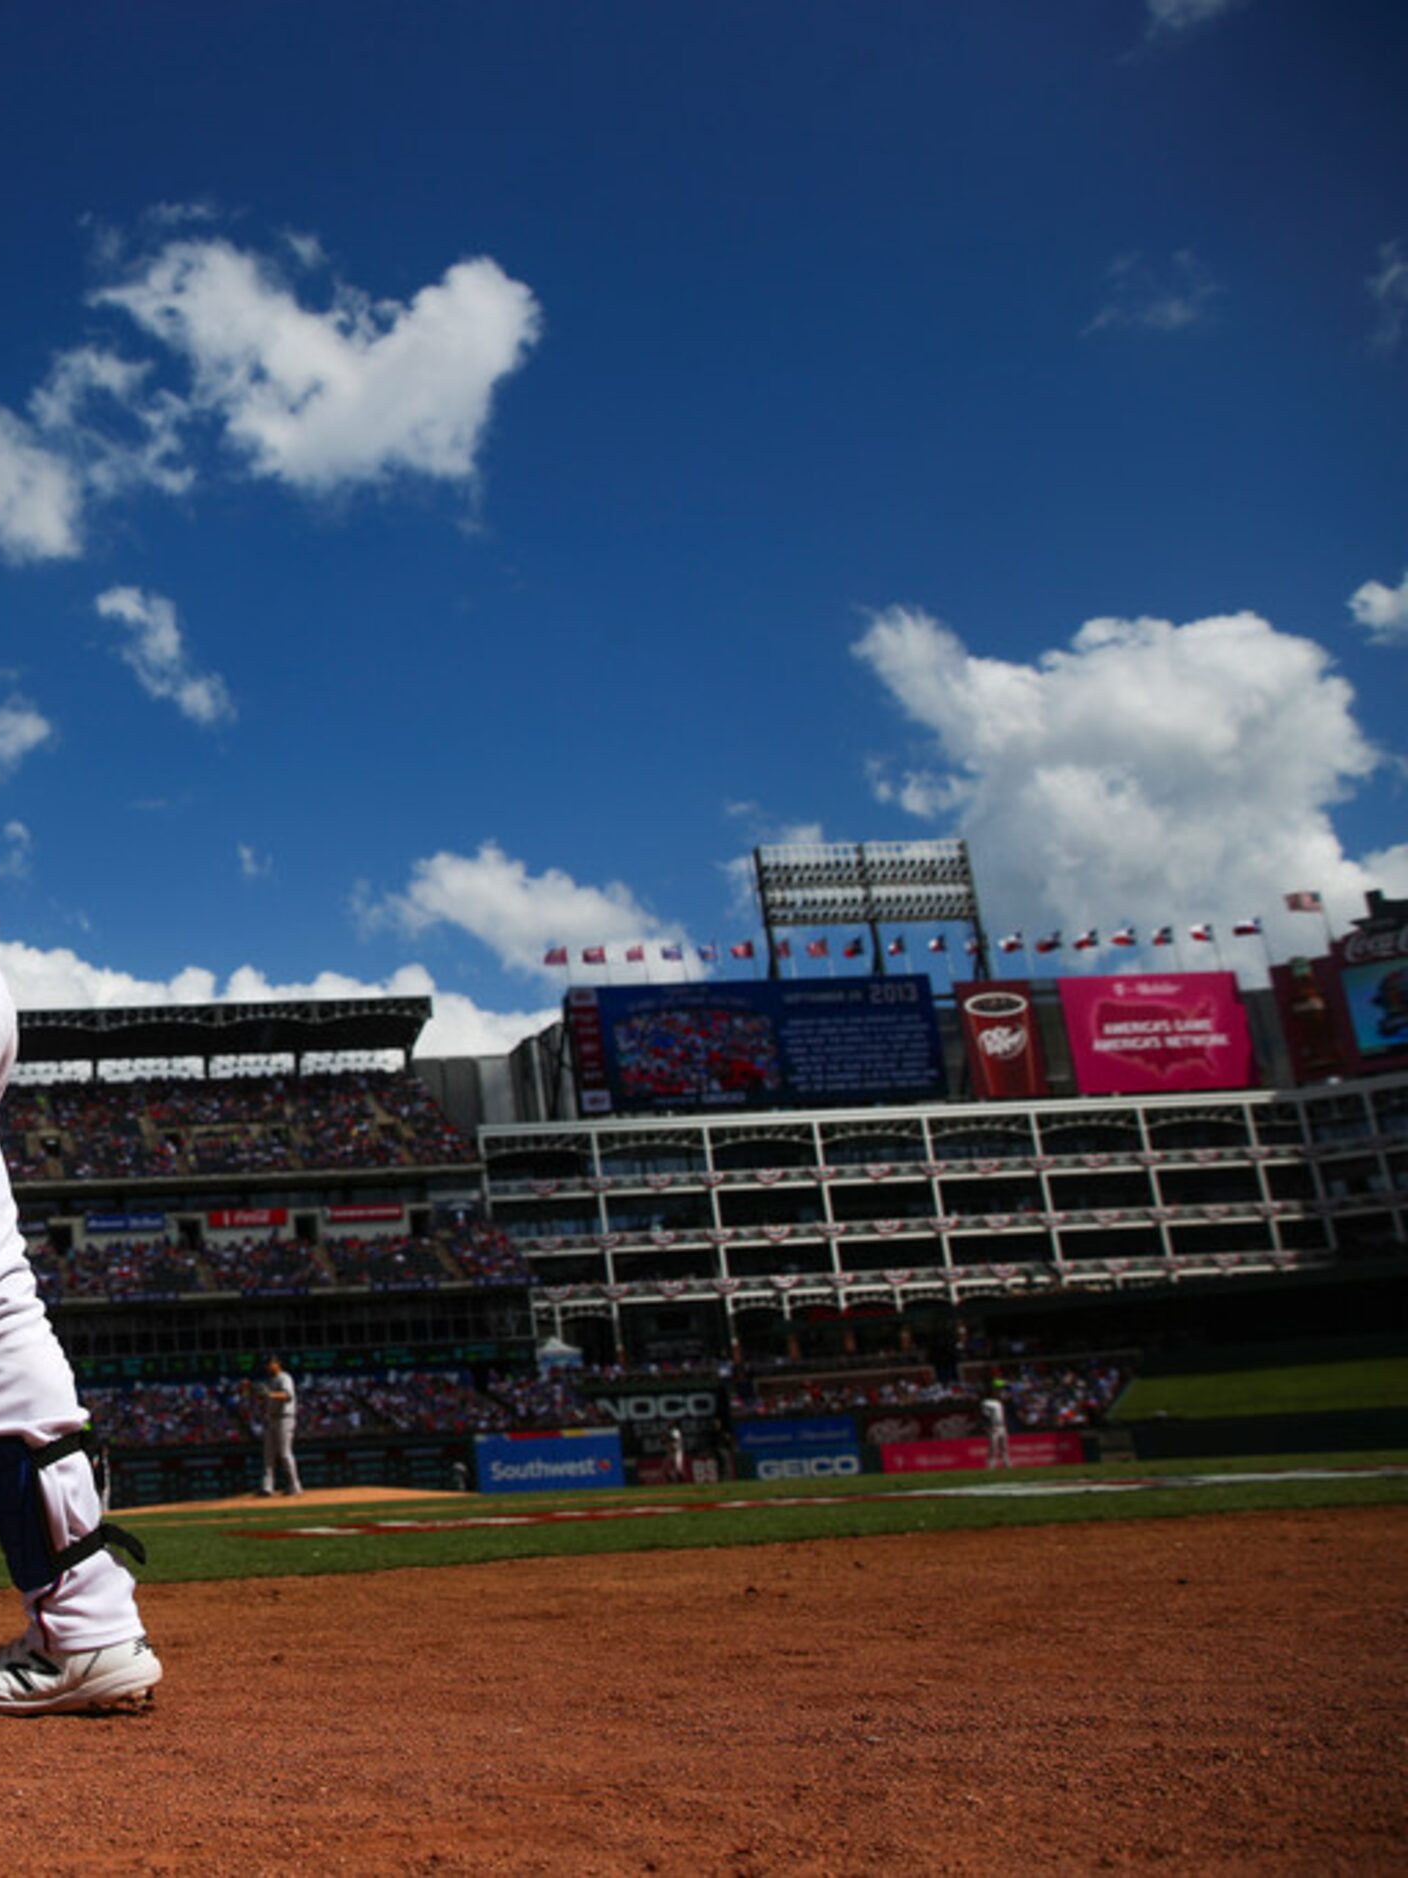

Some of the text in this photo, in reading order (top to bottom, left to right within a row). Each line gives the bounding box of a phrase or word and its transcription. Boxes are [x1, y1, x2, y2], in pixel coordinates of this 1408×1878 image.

[868, 981, 918, 1004] 2013
[490, 1459, 597, 1481] Southwest
[756, 1454, 860, 1481] GEICO
